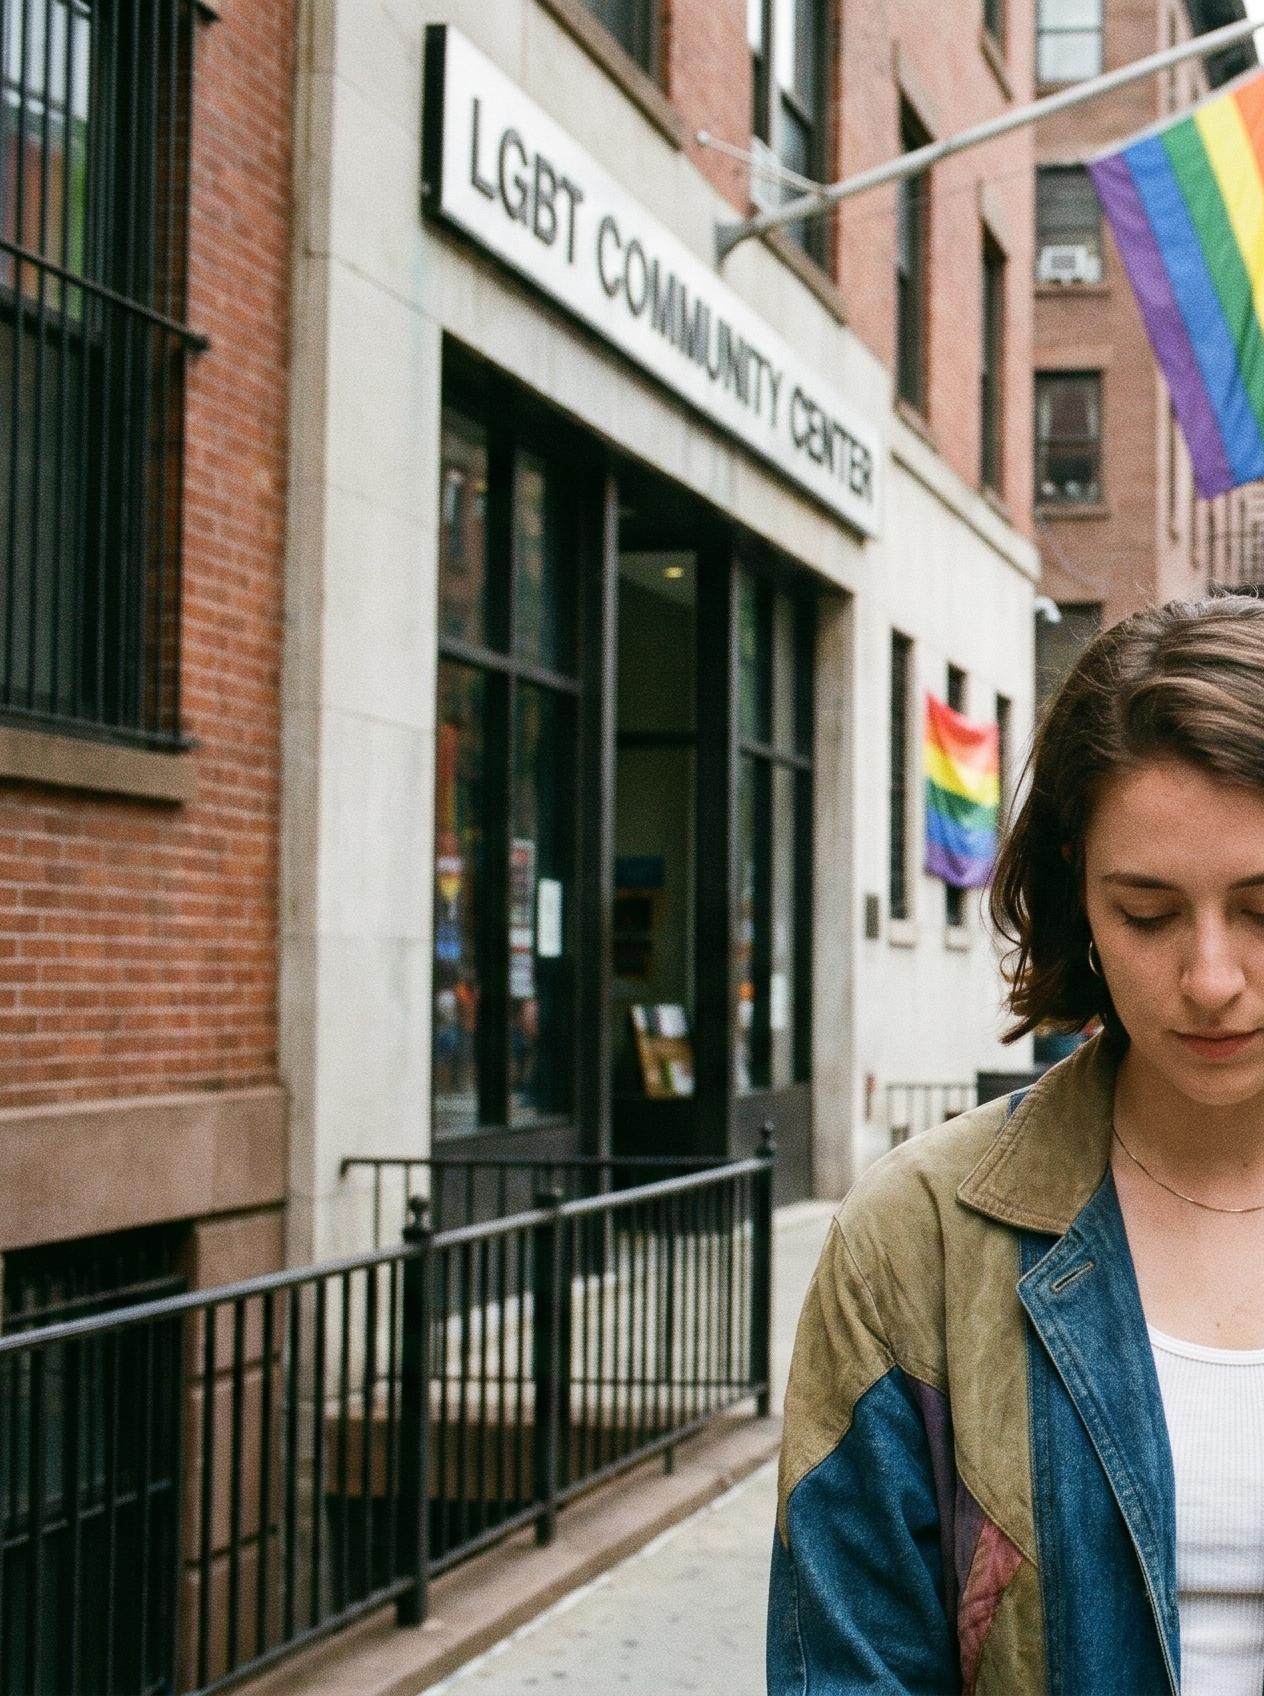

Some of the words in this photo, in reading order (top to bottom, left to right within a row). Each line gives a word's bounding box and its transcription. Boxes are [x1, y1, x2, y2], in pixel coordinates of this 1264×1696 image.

[471, 97, 583, 265] LGBT
[597, 215, 783, 428] COMMUNITY
[789, 386, 873, 507] CENTER
